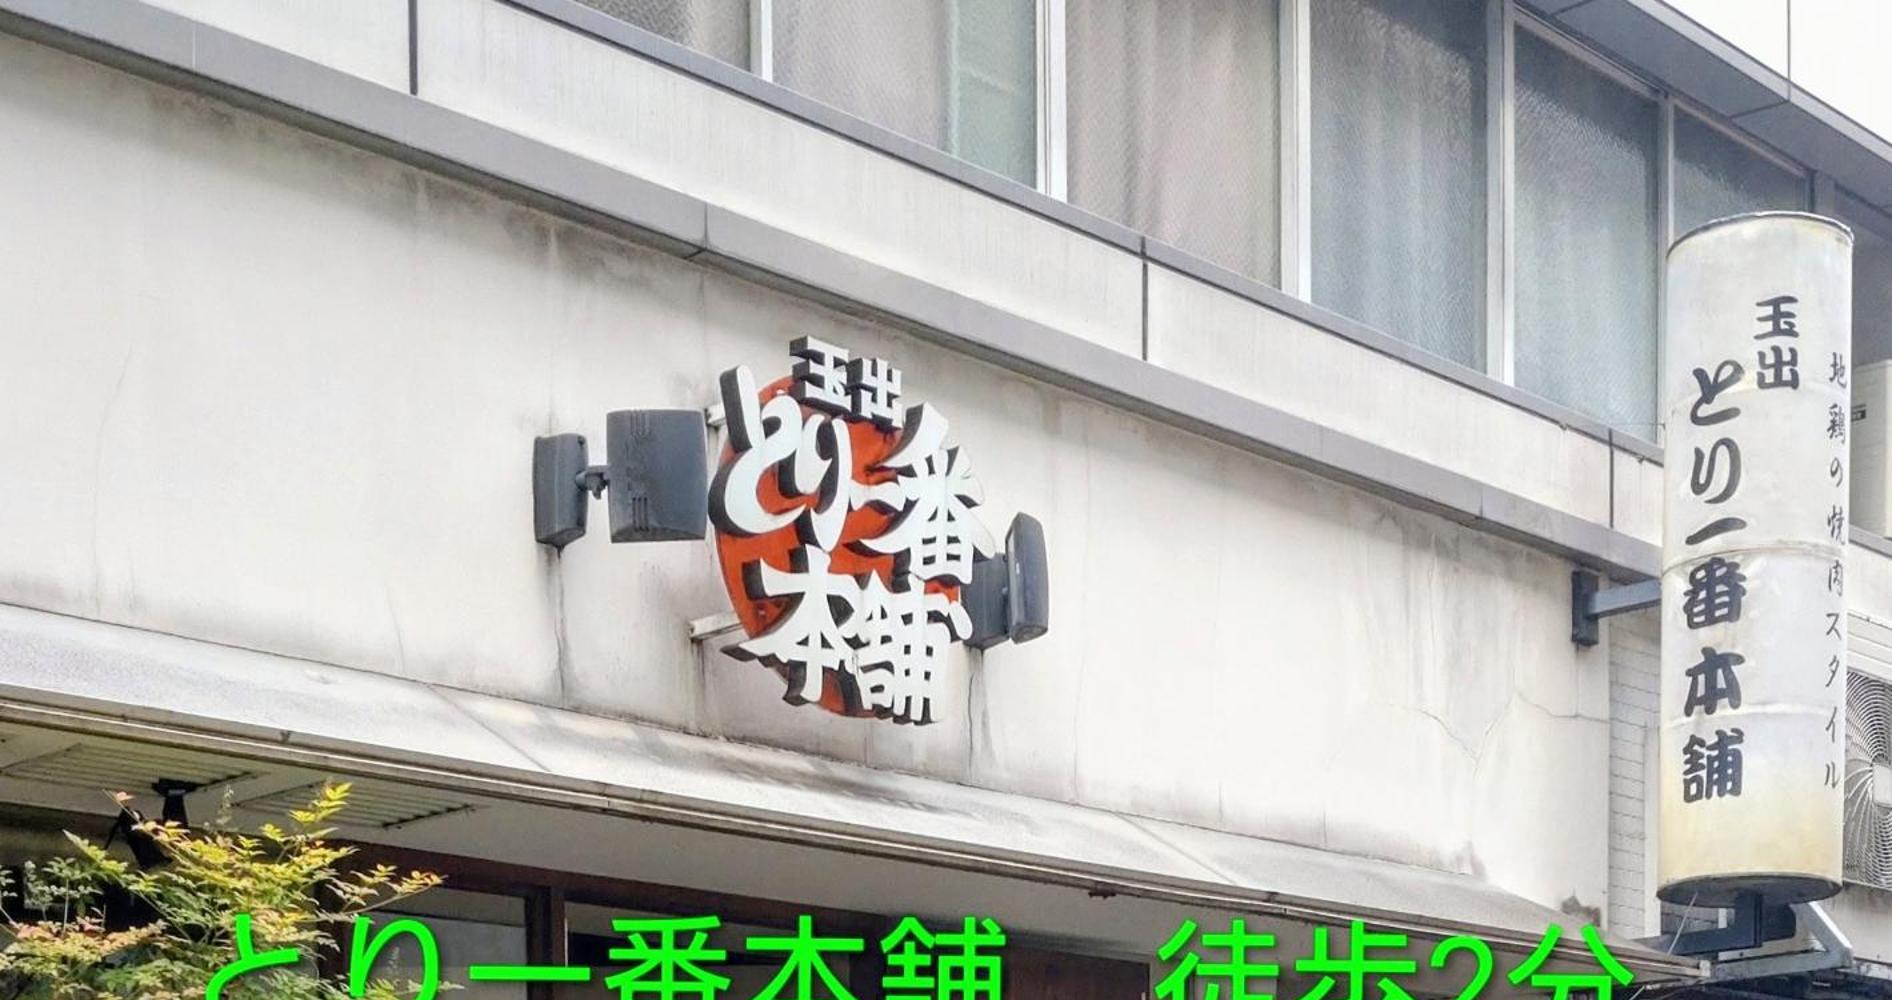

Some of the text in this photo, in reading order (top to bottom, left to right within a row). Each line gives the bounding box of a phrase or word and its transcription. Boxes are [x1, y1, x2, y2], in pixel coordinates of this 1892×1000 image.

[791, 335, 902, 428] 玉出
[1754, 296, 1799, 389] 玉出
[1683, 359, 1747, 803] とり一番本舗
